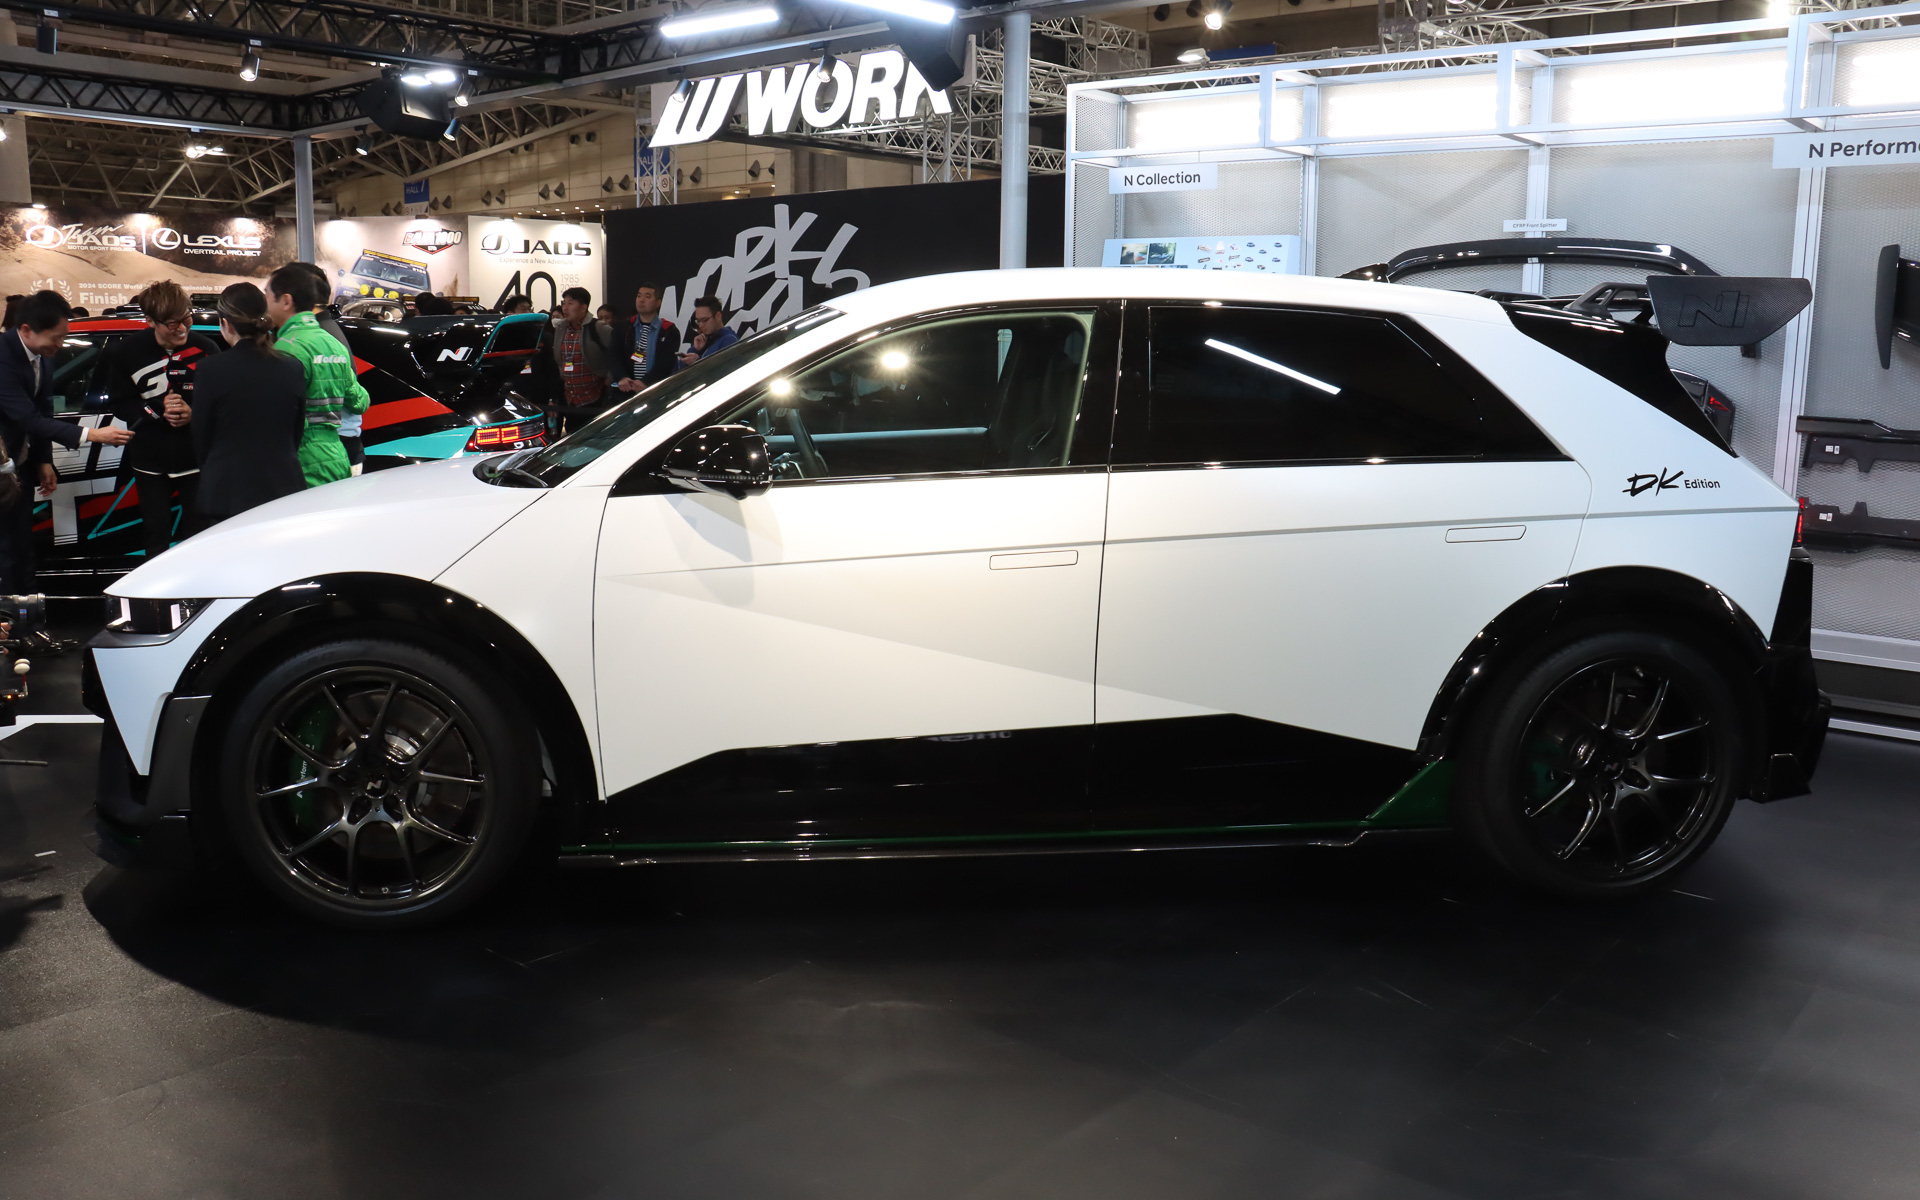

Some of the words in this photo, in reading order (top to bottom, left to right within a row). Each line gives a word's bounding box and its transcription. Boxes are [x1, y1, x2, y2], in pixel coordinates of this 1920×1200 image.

[1808, 143, 1824, 158] N
[1830, 139, 1920, 158] Perform
[1124, 175, 1133, 186] N
[1136, 171, 1201, 186] Collection
[183, 234, 262, 249] LEXUS
[513, 239, 591, 256] JAOS
[183, 248, 226, 256] OVERTRAIL
[560, 273, 580, 283] 1985
[79, 292, 128, 305] Finish
[1621, 466, 1684, 497] DK
[1684, 479, 1721, 489] Edition
